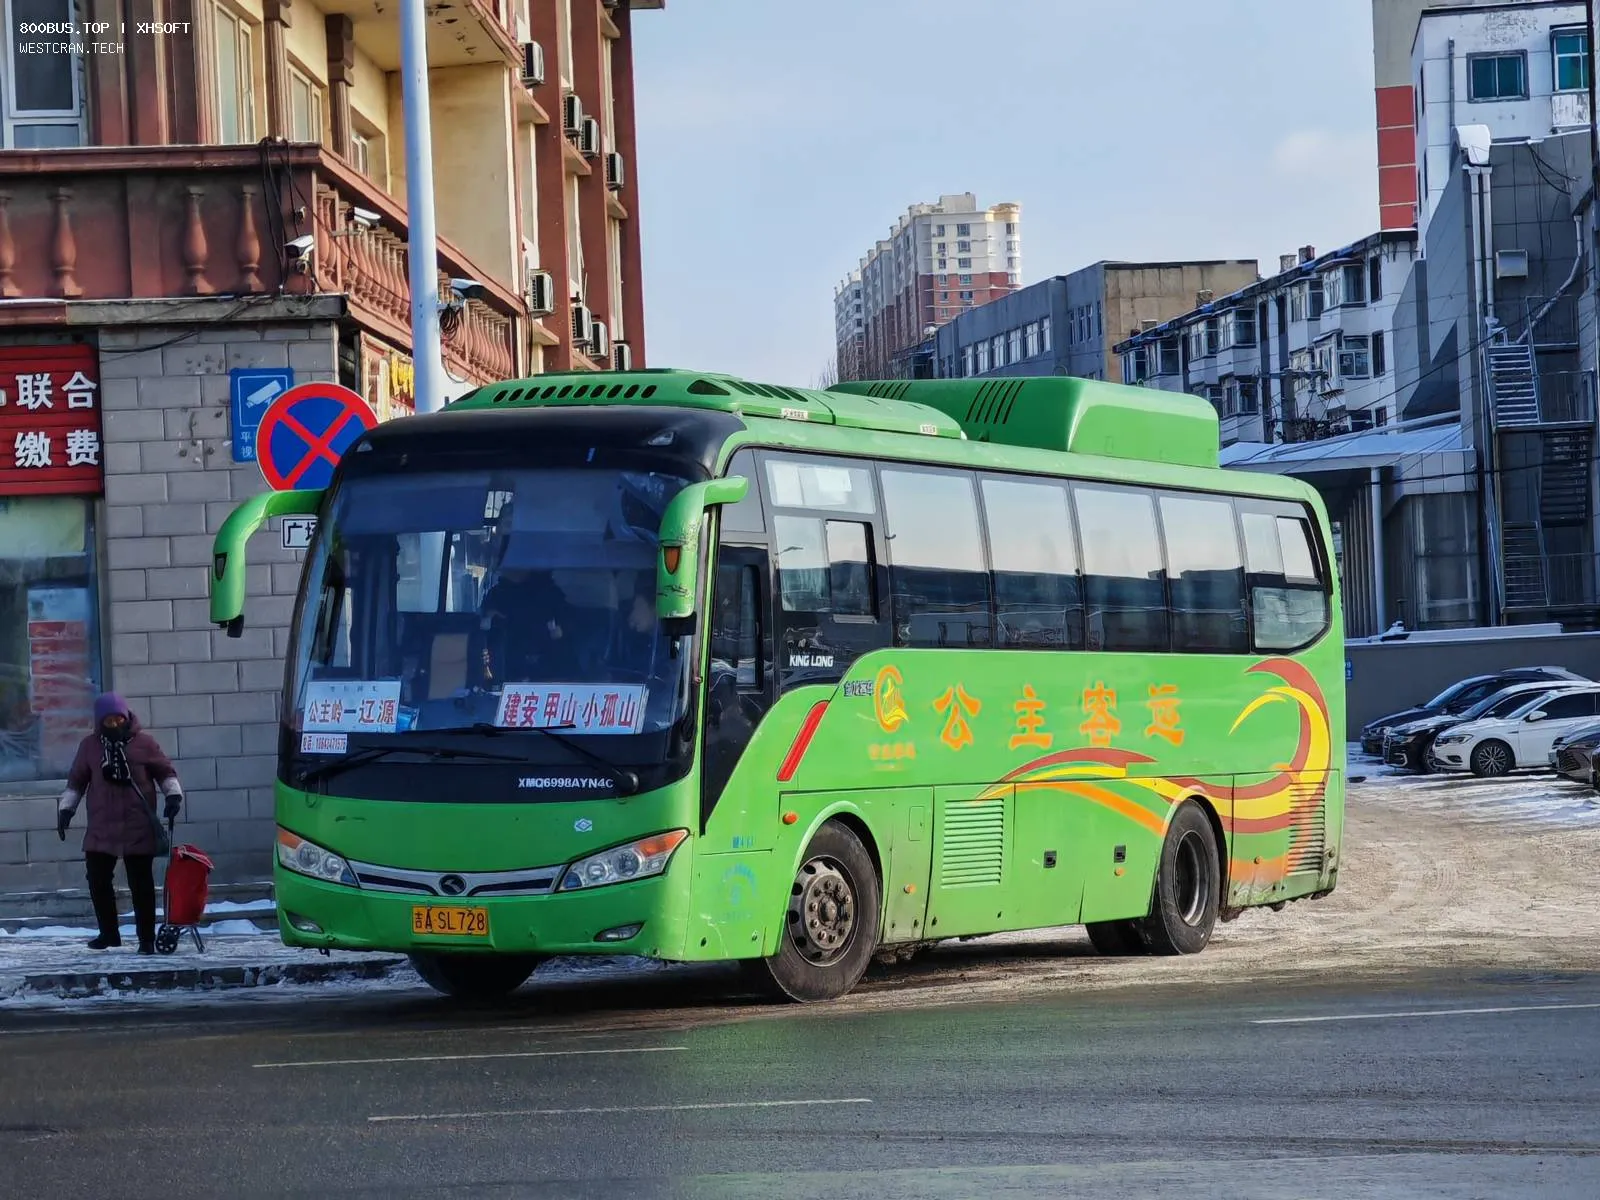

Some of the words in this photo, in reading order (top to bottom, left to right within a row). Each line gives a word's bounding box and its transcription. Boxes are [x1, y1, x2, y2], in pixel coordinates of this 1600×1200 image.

[15, 371, 98, 409] 联合
[14, 429, 100, 468] 缴费
[789, 654, 809, 667] KING
[810, 655, 834, 667] LONG
[502, 692, 539, 726] 建安
[544, 692, 577, 727] 甲山
[582, 692, 636, 728] 小孤山
[518, 777, 614, 789] XMQ6998AYN4C
